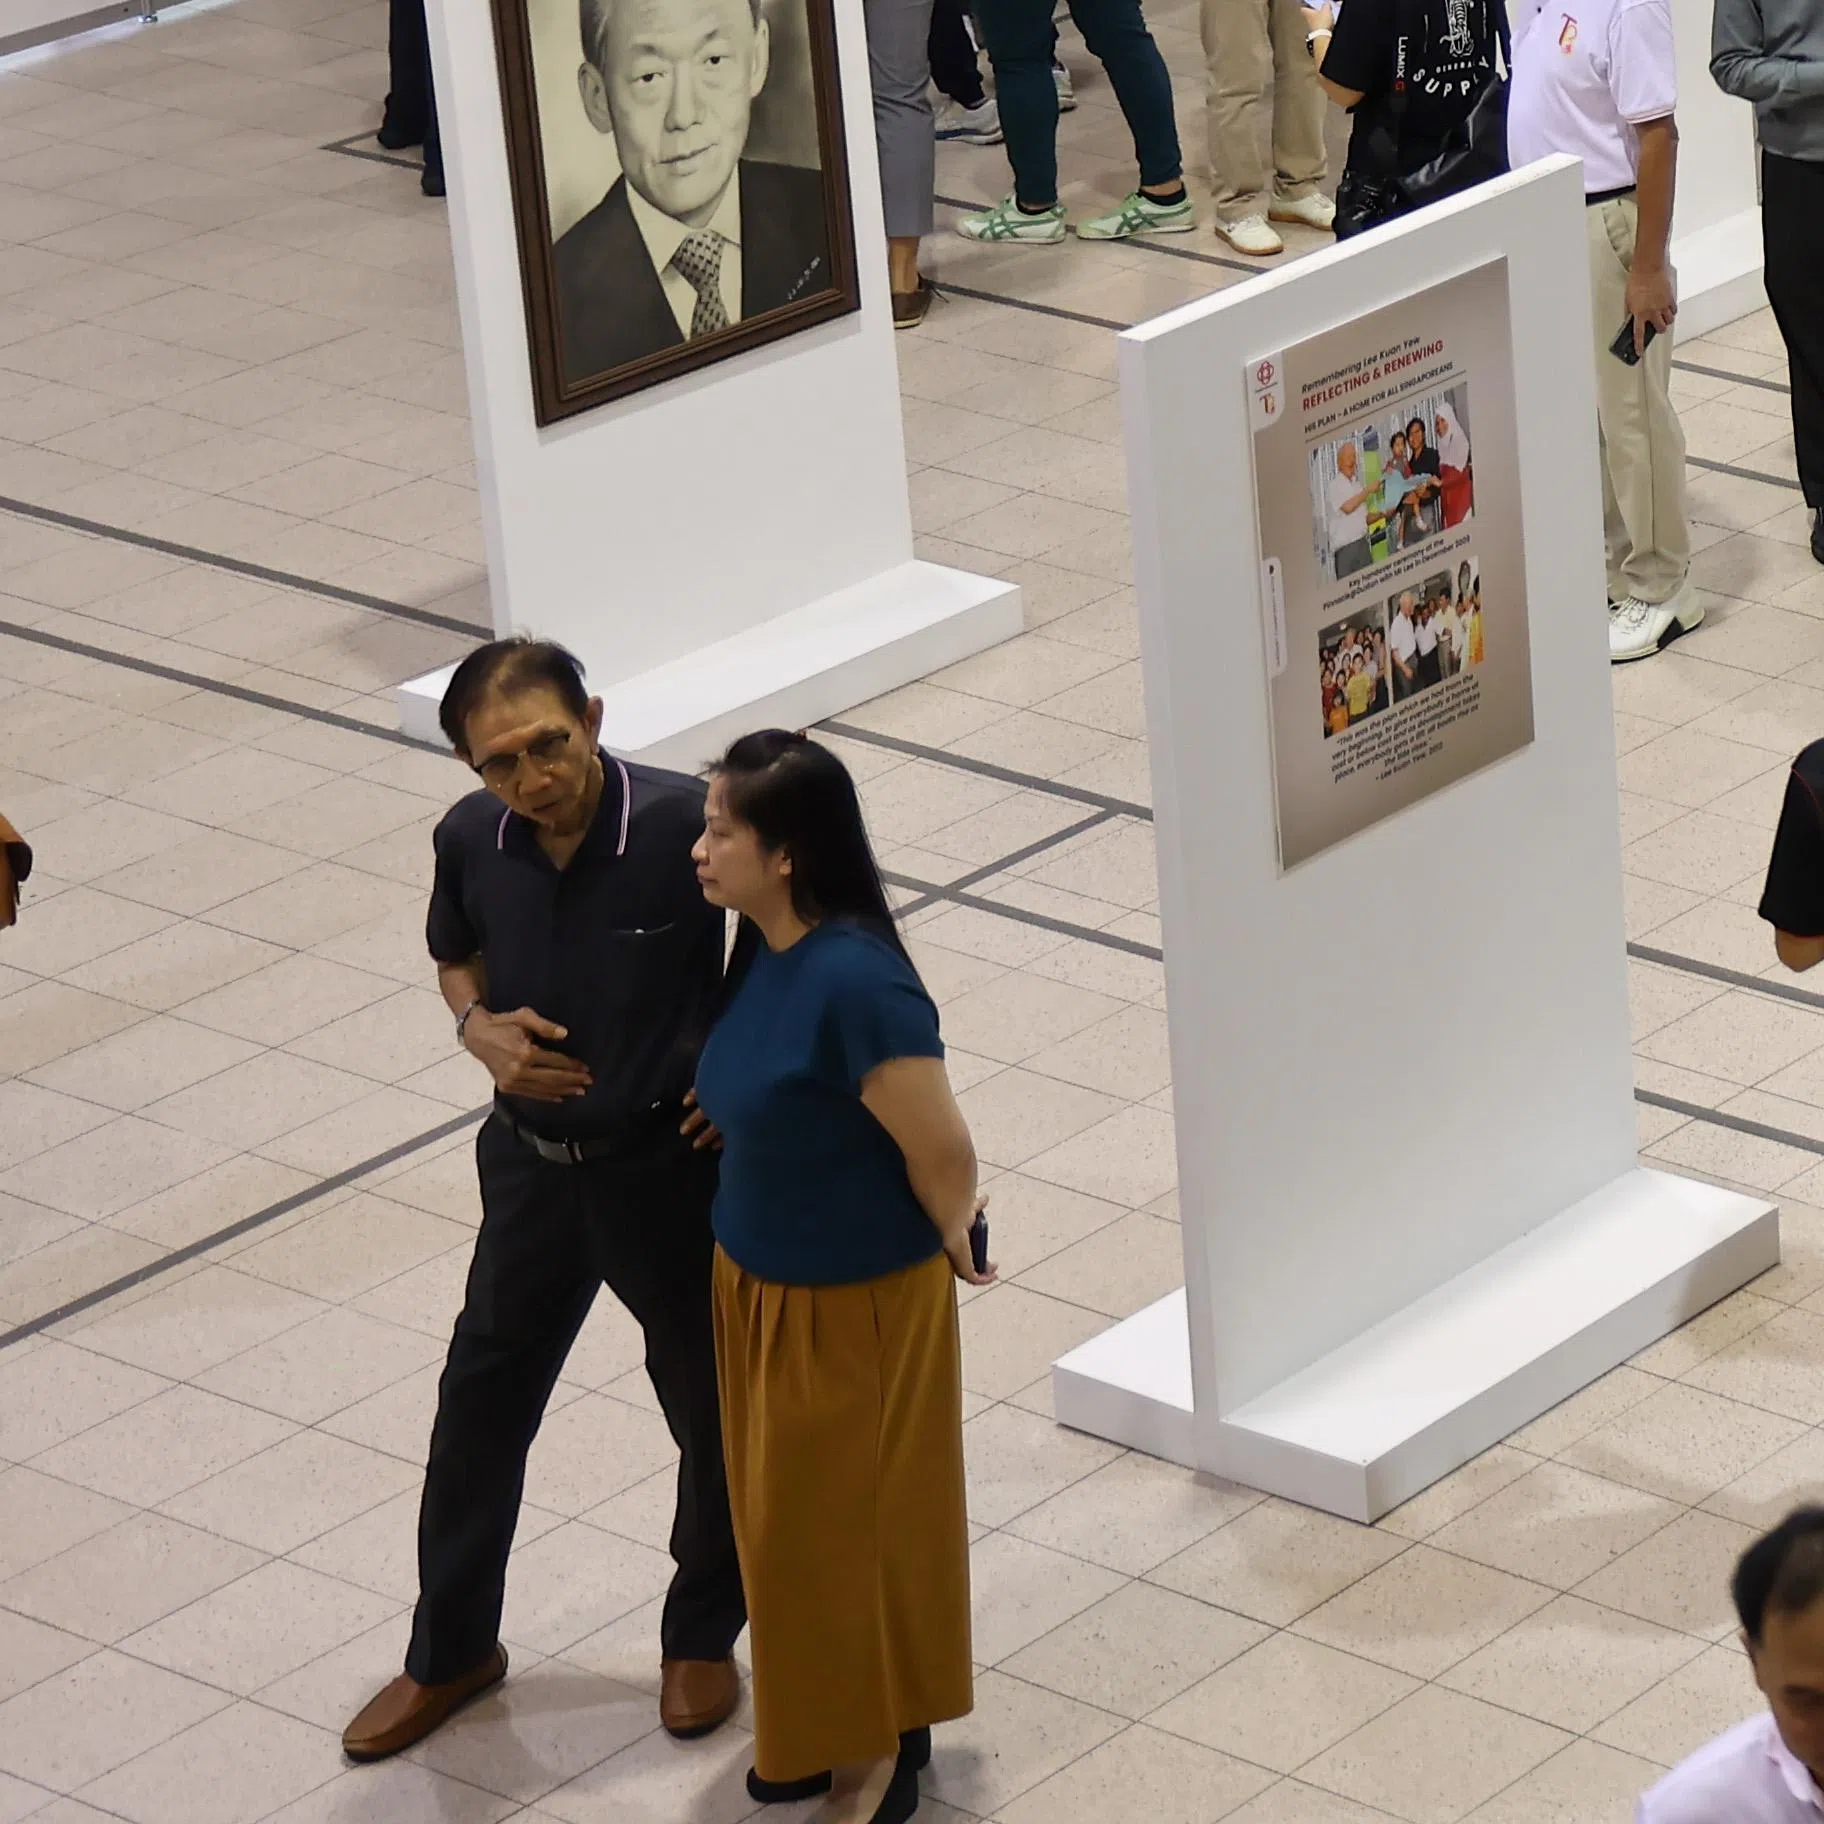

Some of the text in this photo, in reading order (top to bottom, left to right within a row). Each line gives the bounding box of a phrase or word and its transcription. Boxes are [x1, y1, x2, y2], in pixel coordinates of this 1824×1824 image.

[1396, 36, 1409, 78] LUMIX
[1436, 60, 1476, 74] GENERA
[1301, 335, 1420, 395] Remembering Lee Kuan Yew
[1302, 339, 1443, 410] REFLECTING & RENEWING
[1304, 421, 1316, 433] HIS
[1317, 412, 1336, 427] PLAN
[1349, 397, 1370, 413] HOME
[1371, 390, 1385, 403] FOR
[1387, 385, 1399, 397] ALL
[1400, 361, 1453, 391] SINGAPOREANS
